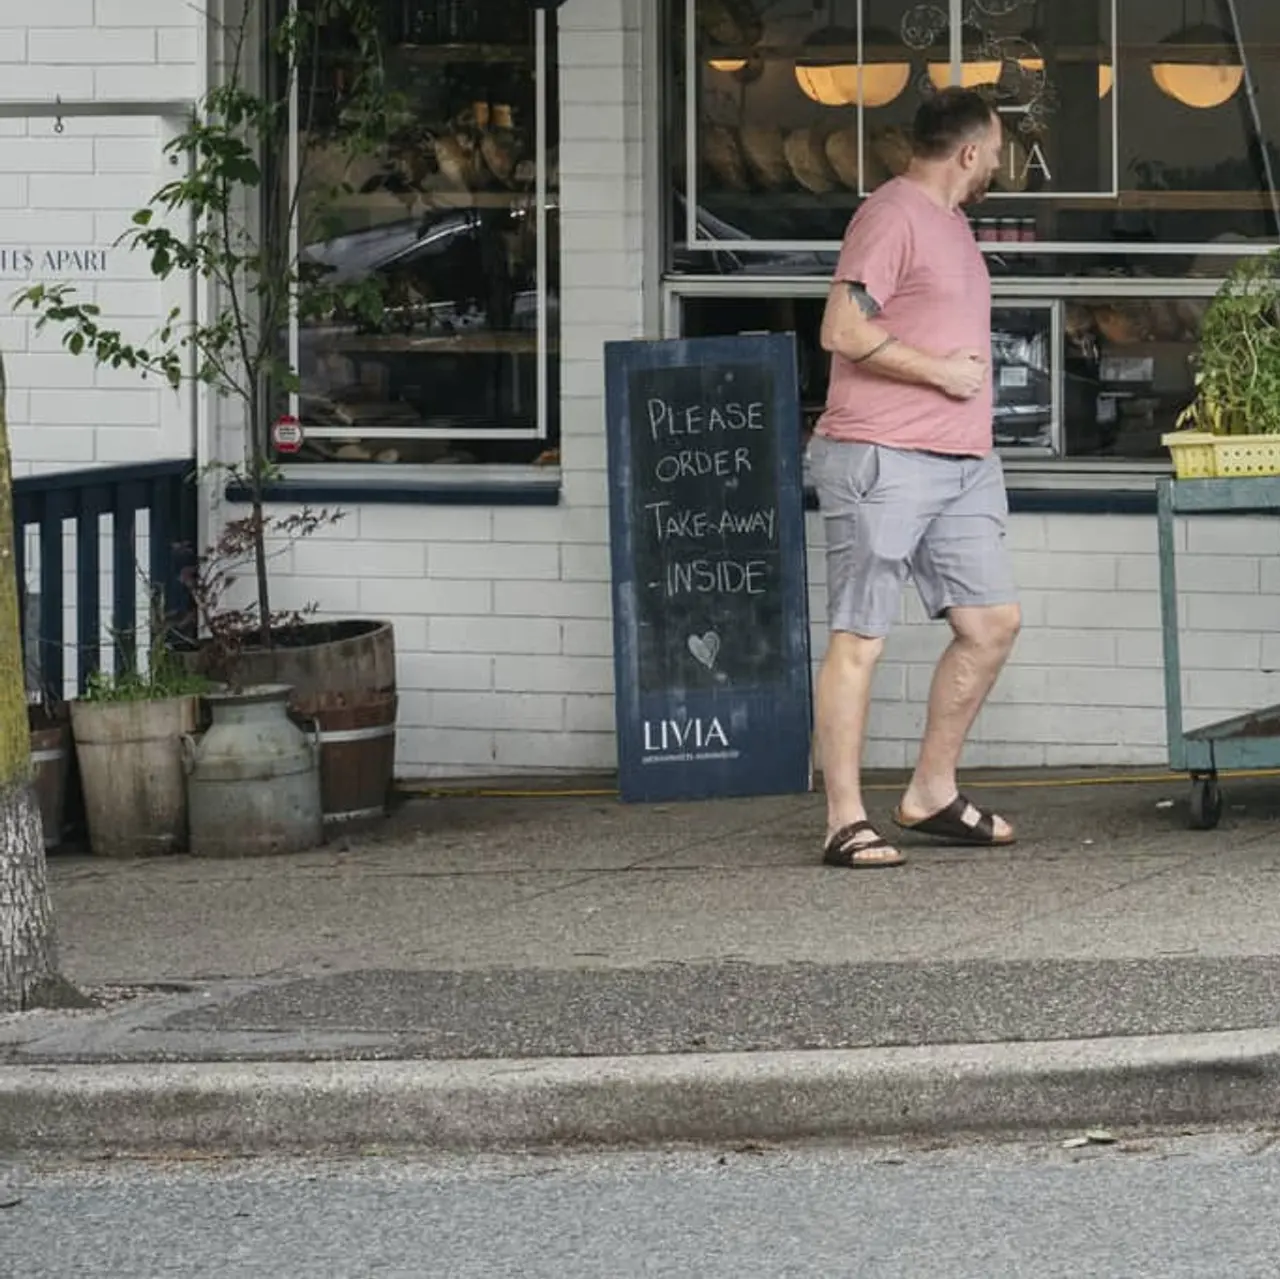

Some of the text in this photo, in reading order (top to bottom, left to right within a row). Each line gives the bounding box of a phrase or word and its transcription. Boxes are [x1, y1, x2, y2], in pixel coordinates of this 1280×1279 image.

[40, 249, 106, 272] APART
[647, 398, 764, 442] PLEASE
[655, 446, 752, 483] ORDER
[644, 716, 729, 750] LIVIA
